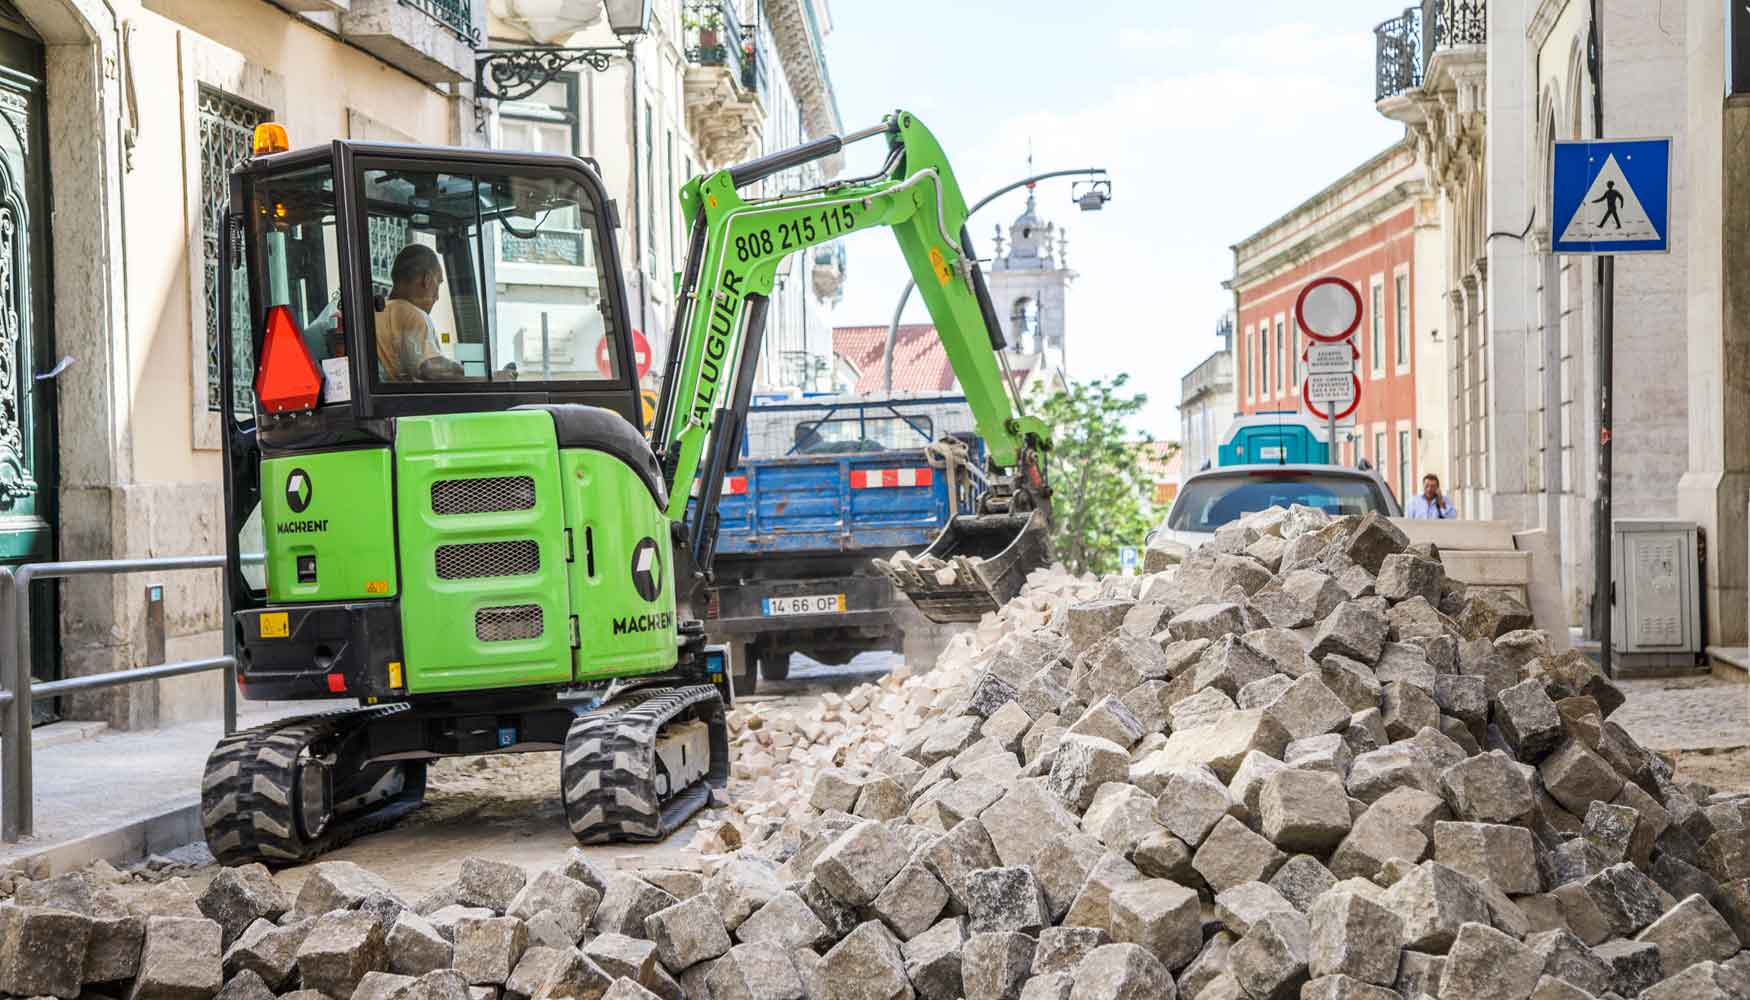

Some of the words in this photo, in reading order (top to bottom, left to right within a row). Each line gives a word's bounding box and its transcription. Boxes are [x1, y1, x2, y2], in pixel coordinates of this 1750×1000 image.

[735, 228, 774, 262] 808
[778, 215, 815, 250] 215
[820, 205, 855, 236] 115
[695, 268, 744, 430] ALUGUER
[277, 519, 329, 535] MACHRENT
[772, 599, 785, 613] 14
[791, 598, 809, 612] 66
[612, 611, 673, 636] MACHREN
